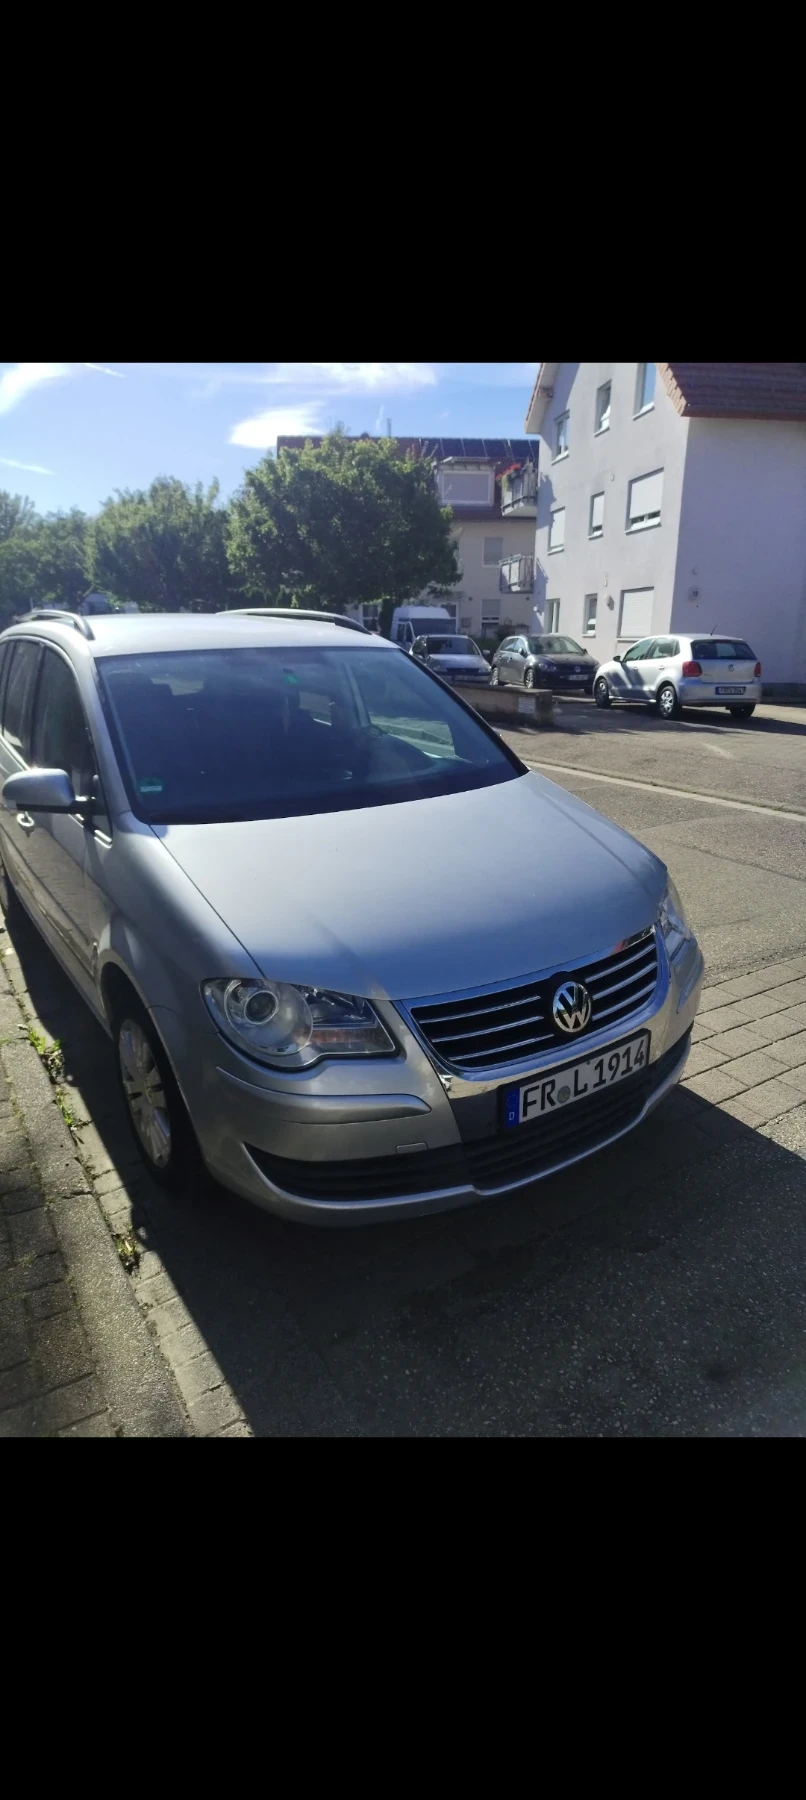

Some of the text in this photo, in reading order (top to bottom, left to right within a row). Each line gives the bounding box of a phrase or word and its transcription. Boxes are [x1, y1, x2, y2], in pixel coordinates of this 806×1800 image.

[522, 1040, 644, 1117] FR L 1914
[508, 1112, 515, 1121] D
